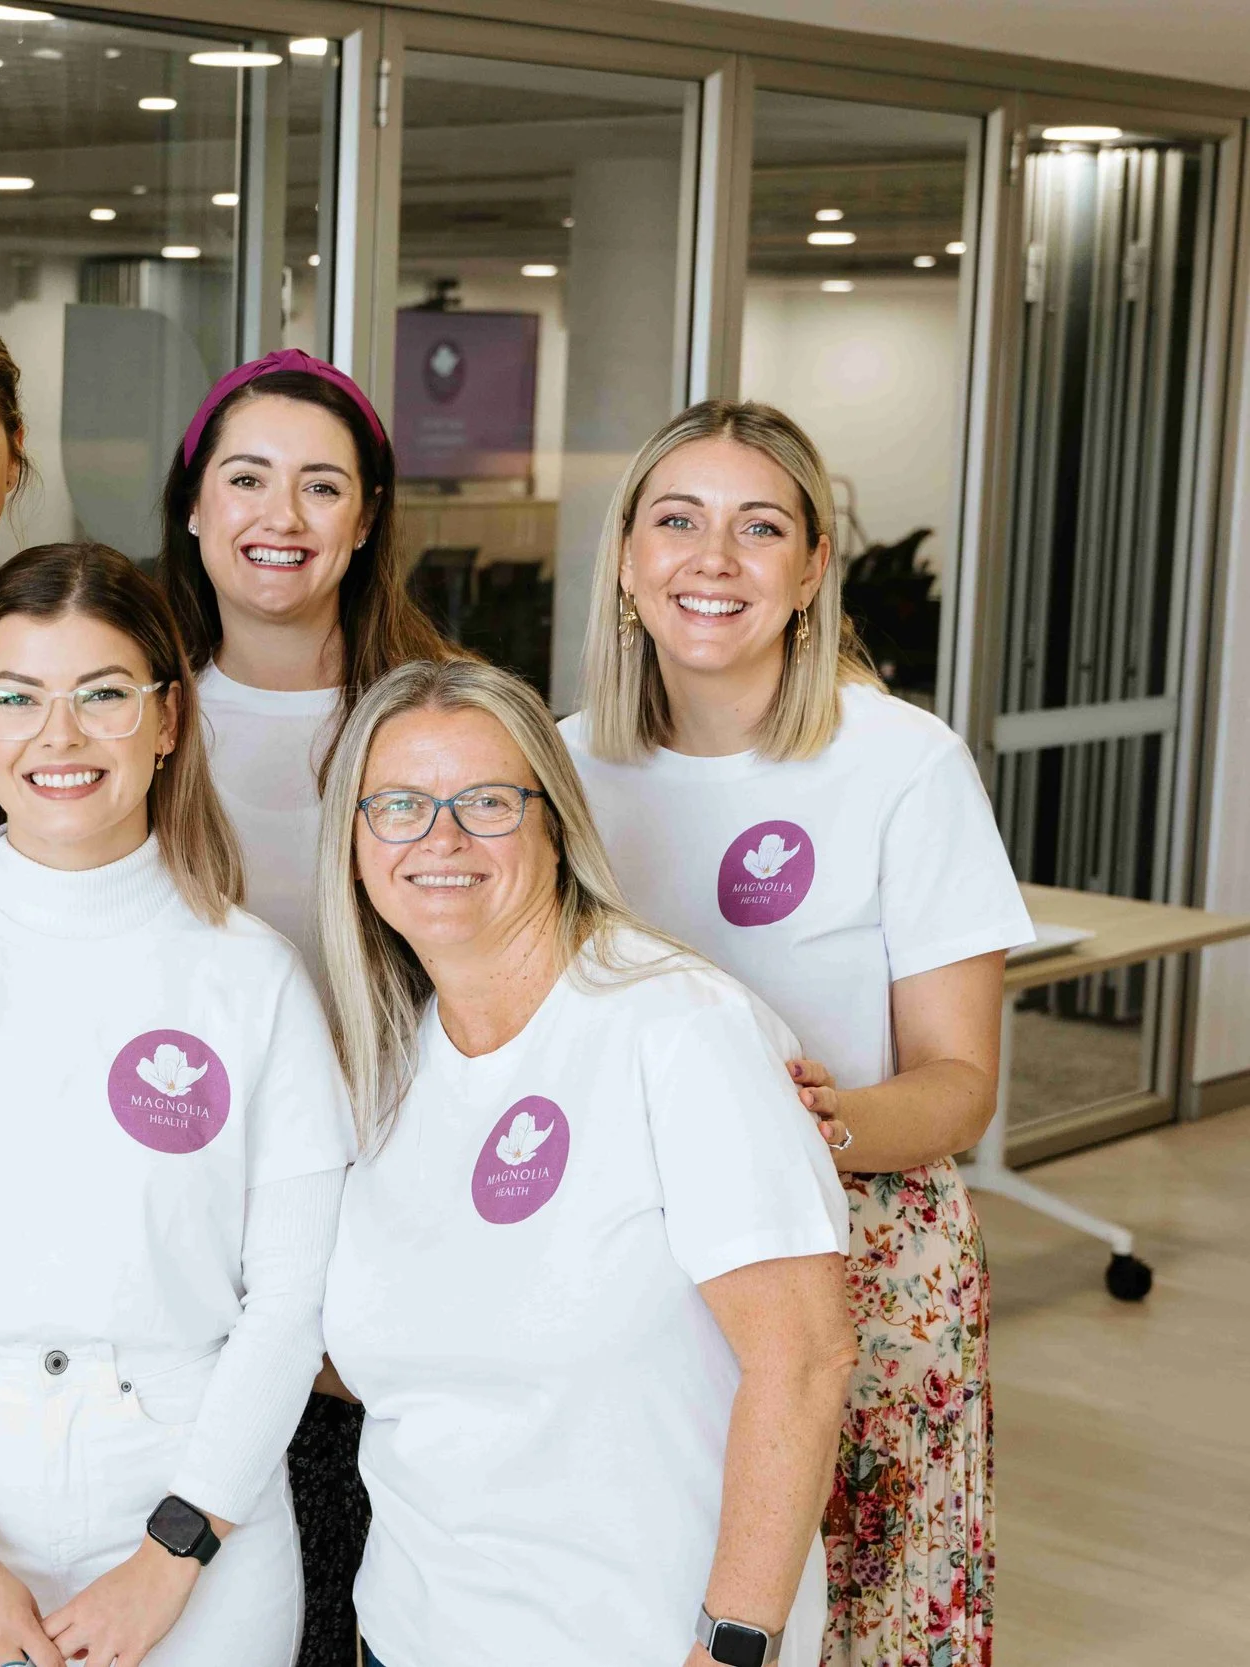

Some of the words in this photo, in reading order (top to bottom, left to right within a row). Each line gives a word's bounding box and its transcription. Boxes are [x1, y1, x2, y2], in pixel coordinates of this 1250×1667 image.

[732, 882, 792, 893] MAGNOLIA
[740, 896, 771, 905] HEALTH
[131, 1095, 210, 1119] MAGNOLIA
[149, 1114, 189, 1129] HEALTH
[486, 1167, 549, 1186] MAGNOLIA
[495, 1186, 529, 1198] HEALTH
